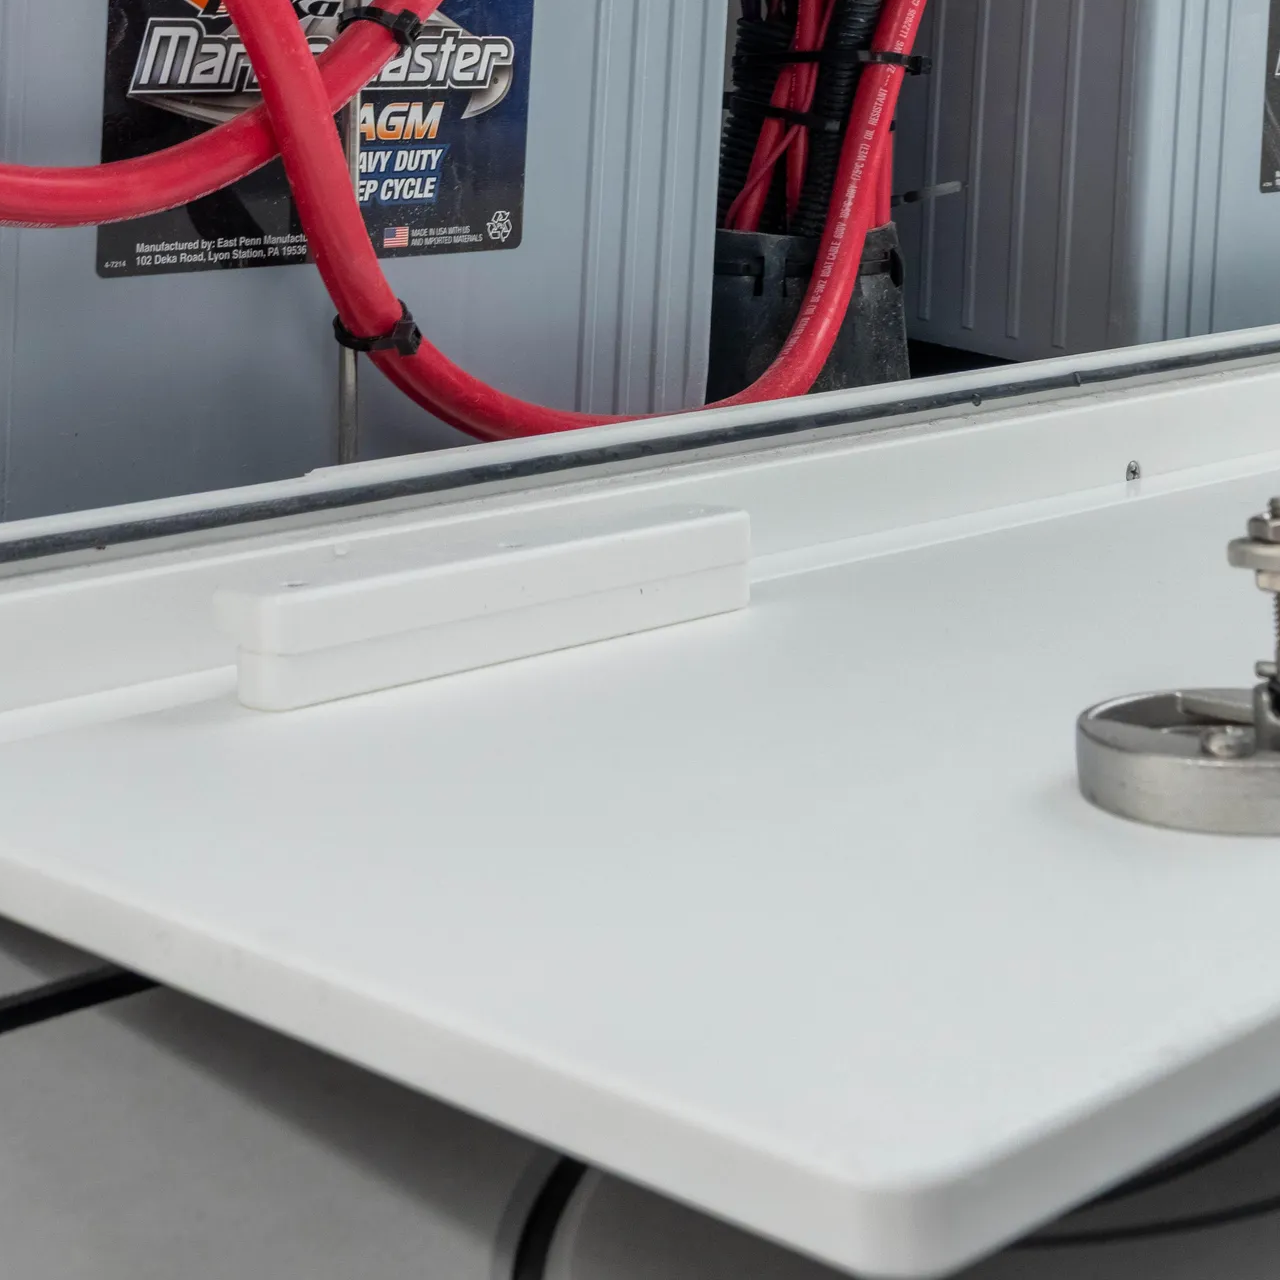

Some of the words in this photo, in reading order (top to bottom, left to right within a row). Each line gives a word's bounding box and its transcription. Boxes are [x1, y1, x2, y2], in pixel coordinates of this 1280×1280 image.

[867, 88, 888, 126] RESISTANT
[360, 101, 445, 142] AGM
[863, 128, 875, 141] OIL
[359, 150, 393, 173] AVY
[393, 148, 444, 172] DUTY
[359, 178, 379, 202] EP
[379, 176, 437, 201] CYCLE
[411, 228, 428, 237] MADE
[429, 228, 435, 236] IN
[436, 227, 447, 236] USA
[448, 226, 462, 235] WITH
[411, 236, 424, 246] AND
[424, 235, 453, 245] IMPORTED
[453, 234, 483, 244] MATERIALS
[135, 241, 200, 253] Manufactured
[201, 239, 216, 251] by:
[217, 237, 238, 248] East
[239, 236, 261, 247] Penn
[827, 241, 842, 261] CABLE
[135, 256, 151, 266] 102
[154, 254, 177, 265] Deka
[179, 252, 206, 263] Road,
[208, 251, 230, 263] Lyon
[232, 248, 266, 260] Station,
[267, 248, 280, 257] PA
[282, 245, 307, 256] 19536
